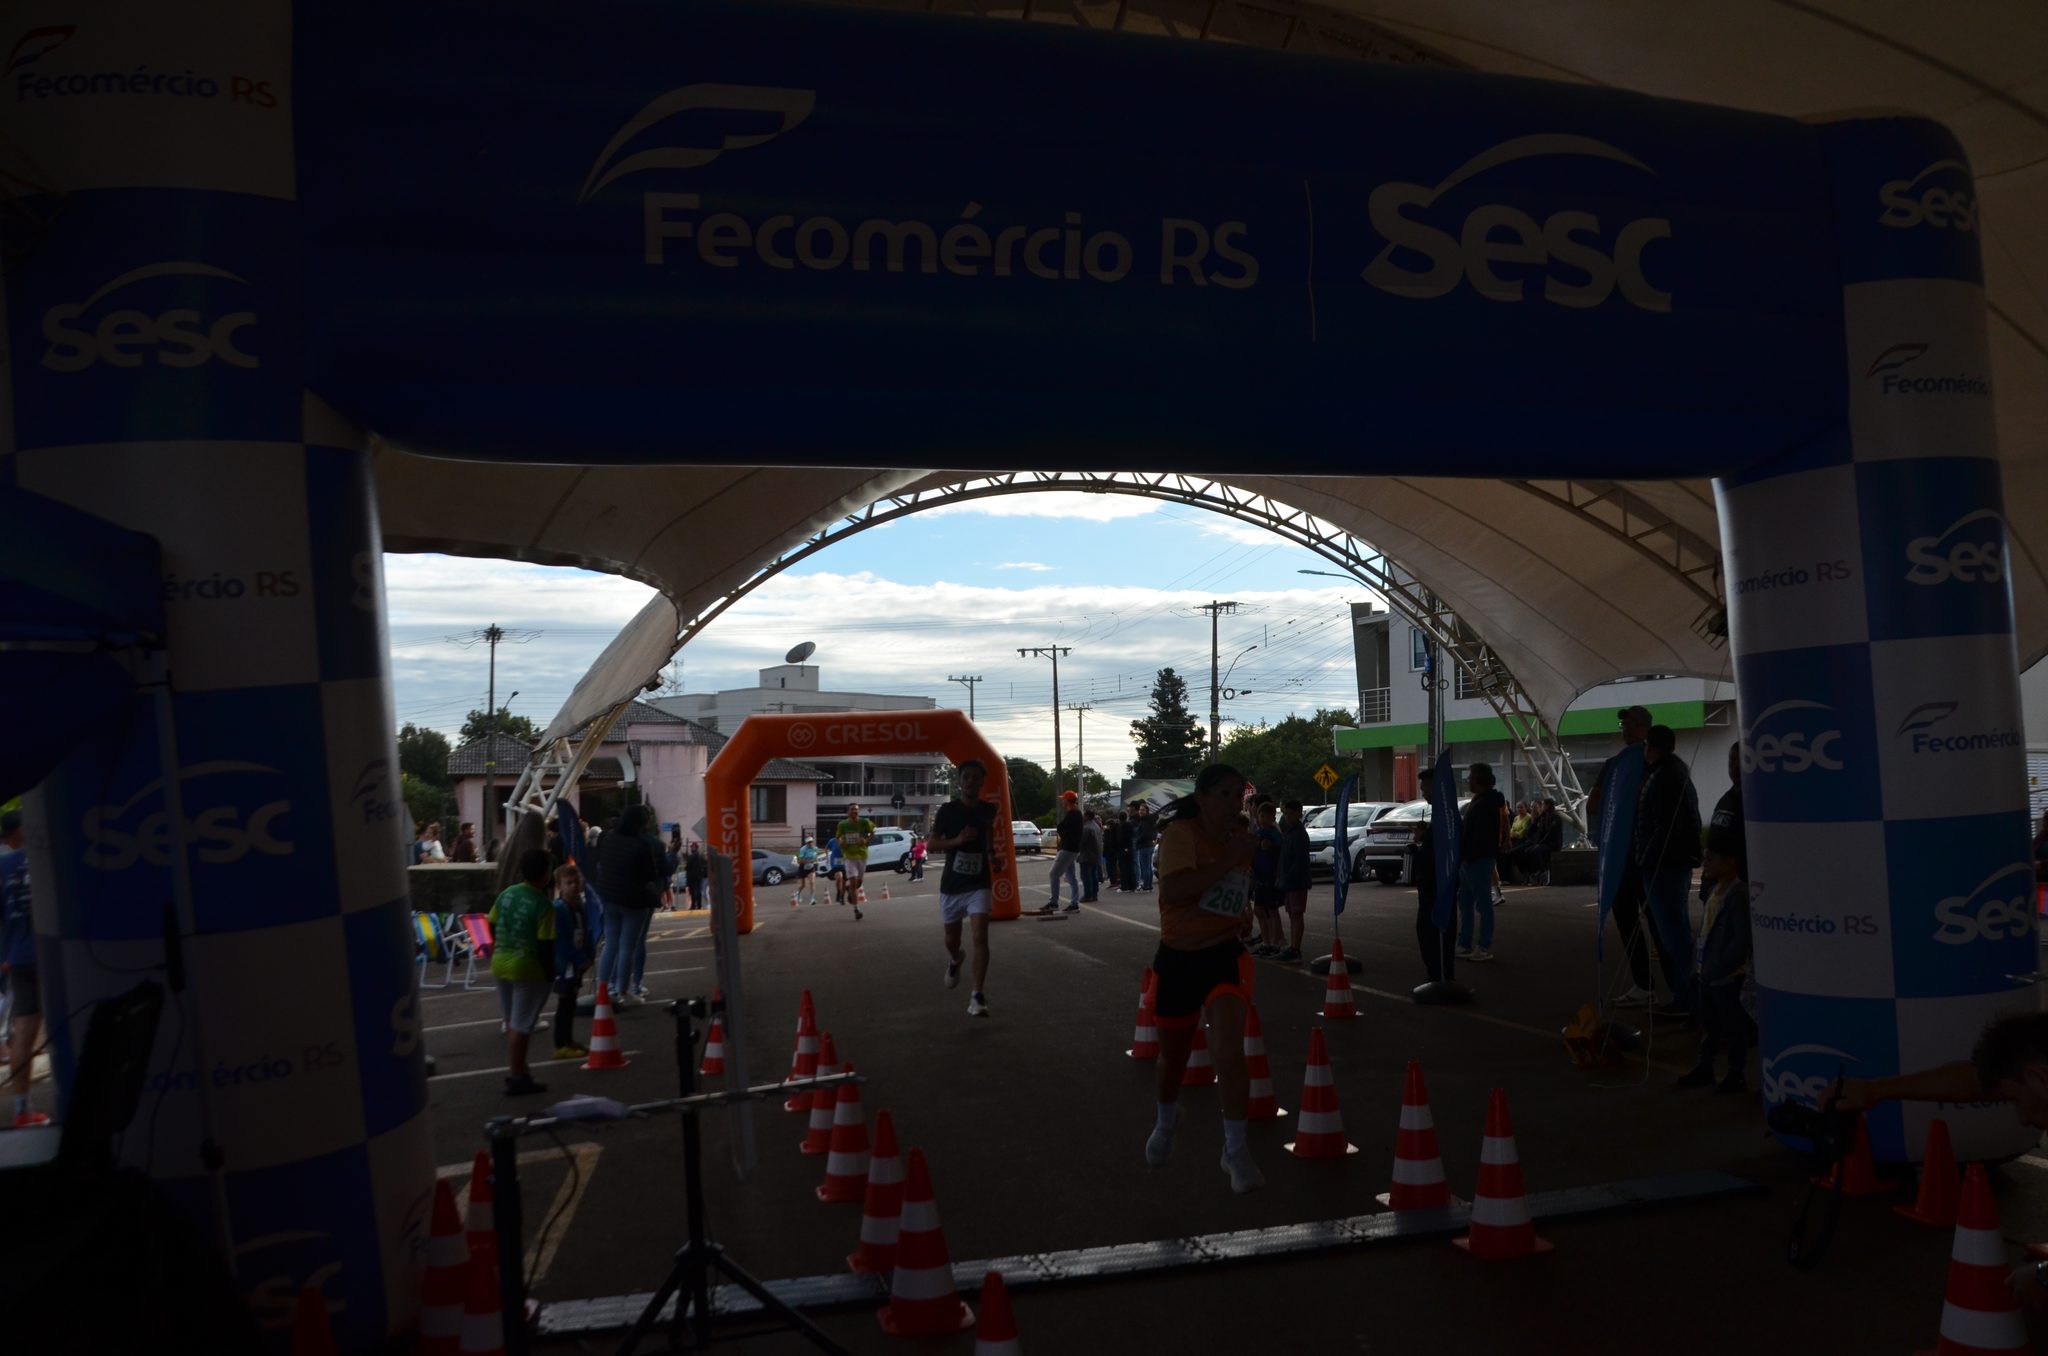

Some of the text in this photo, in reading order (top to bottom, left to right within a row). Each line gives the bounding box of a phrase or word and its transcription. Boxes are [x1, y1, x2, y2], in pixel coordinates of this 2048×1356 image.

[17, 66, 277, 108] Fecomércio RS
[1876, 179, 1977, 232] Ses
[643, 190, 1260, 289] Fecomércio RS
[256, 570, 300, 597] RS
[1816, 560, 1851, 582] RS
[825, 721, 929, 744] CRESOL
[1206, 886, 1243, 914] 268
[1844, 915, 1878, 935] RS
[304, 1041, 344, 1072] RS
